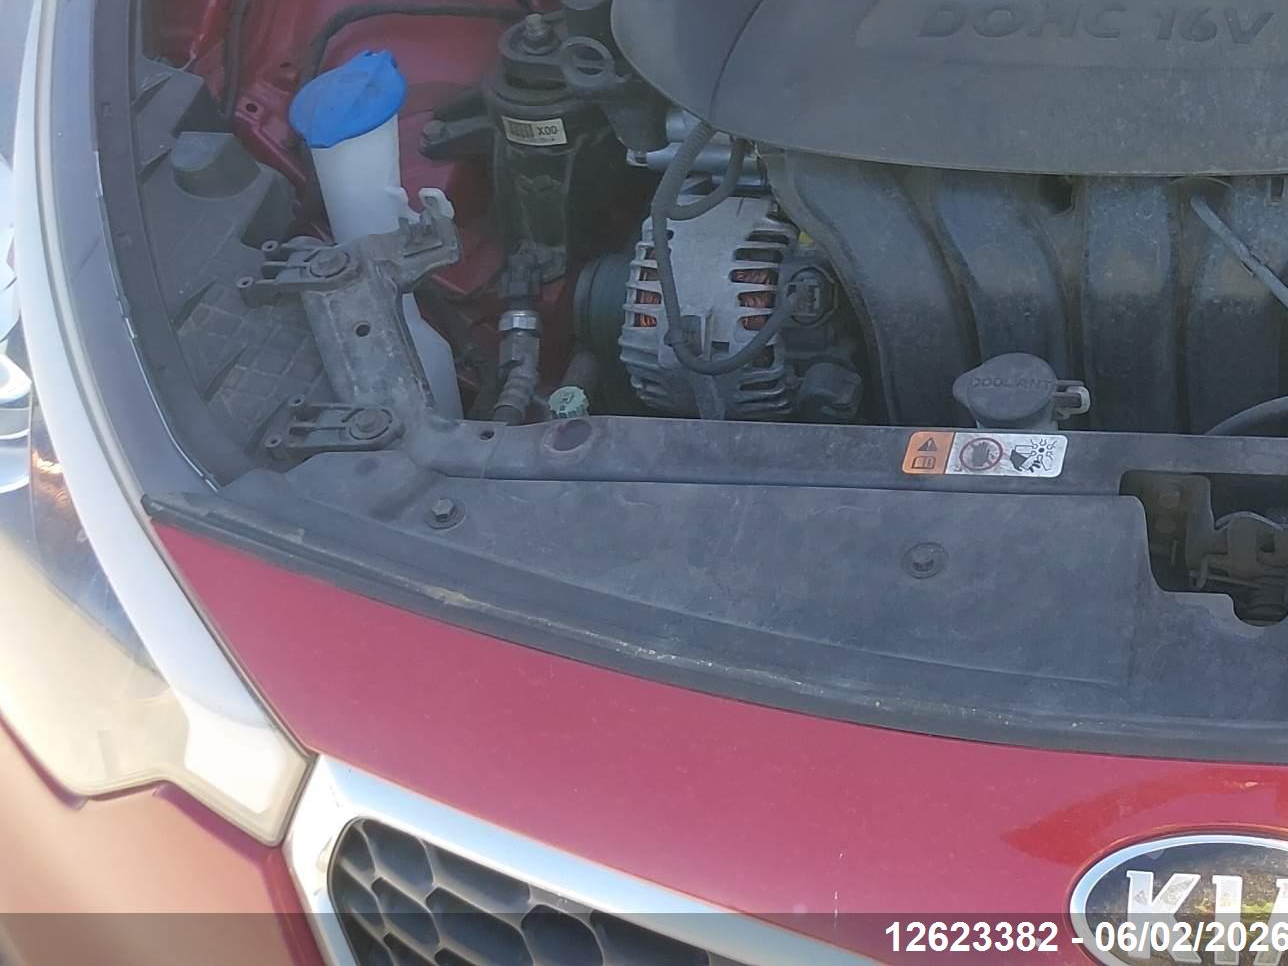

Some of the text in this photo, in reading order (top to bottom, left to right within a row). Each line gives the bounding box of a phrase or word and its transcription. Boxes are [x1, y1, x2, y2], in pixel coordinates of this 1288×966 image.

[917, 6, 1275, 45] DOHC 16V
[969, 377, 1053, 390] COOLANT
